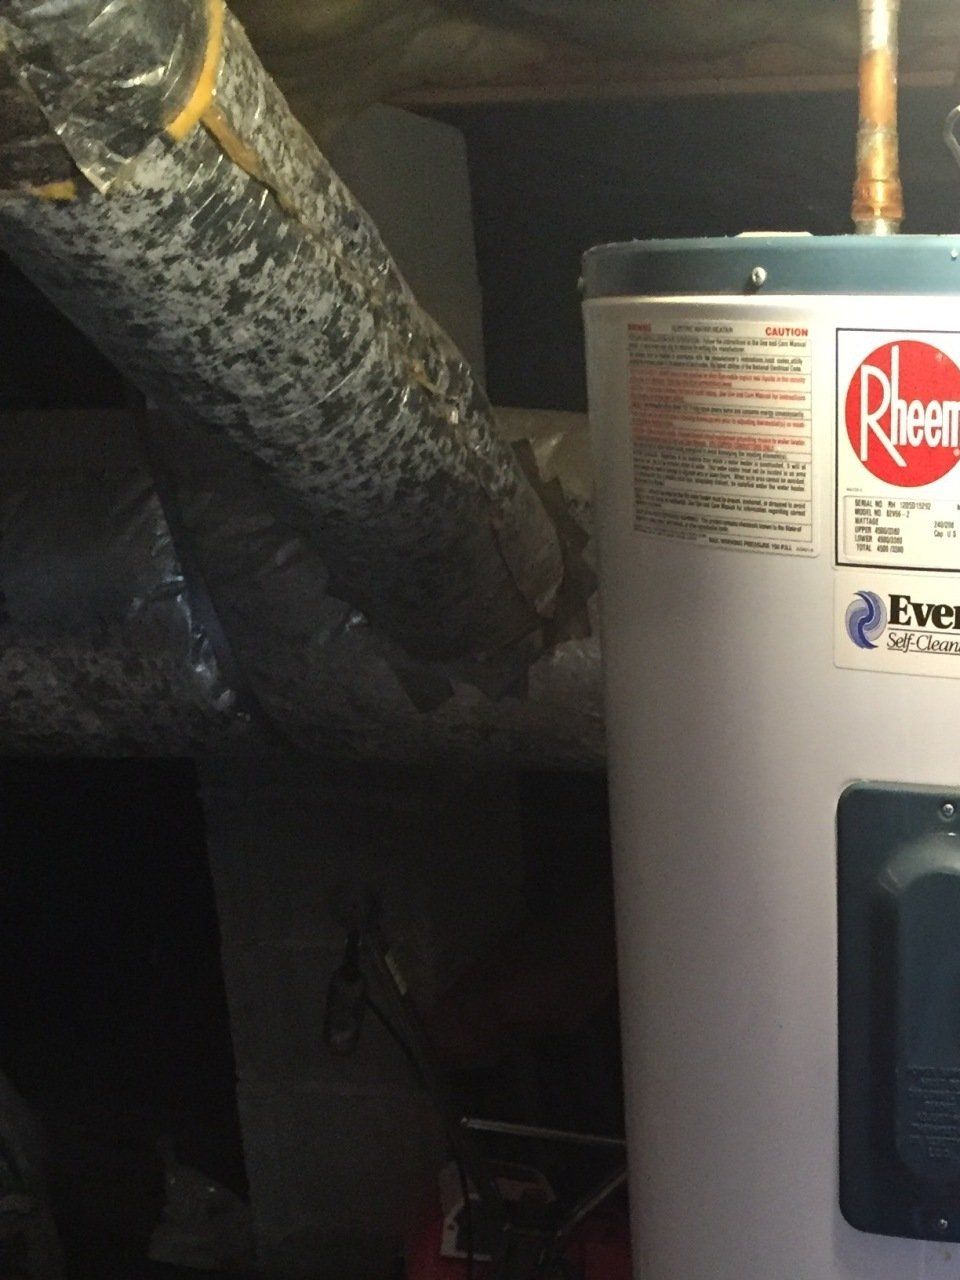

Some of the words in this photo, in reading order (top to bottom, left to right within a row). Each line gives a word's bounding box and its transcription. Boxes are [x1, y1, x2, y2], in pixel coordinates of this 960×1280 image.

[765, 327, 808, 337] CAUTION
[855, 499, 873, 507] SERIAL
[855, 508, 872, 516] MODEL
[855, 517, 879, 525] WATTAGE
[856, 543, 871, 551] TOTAL
